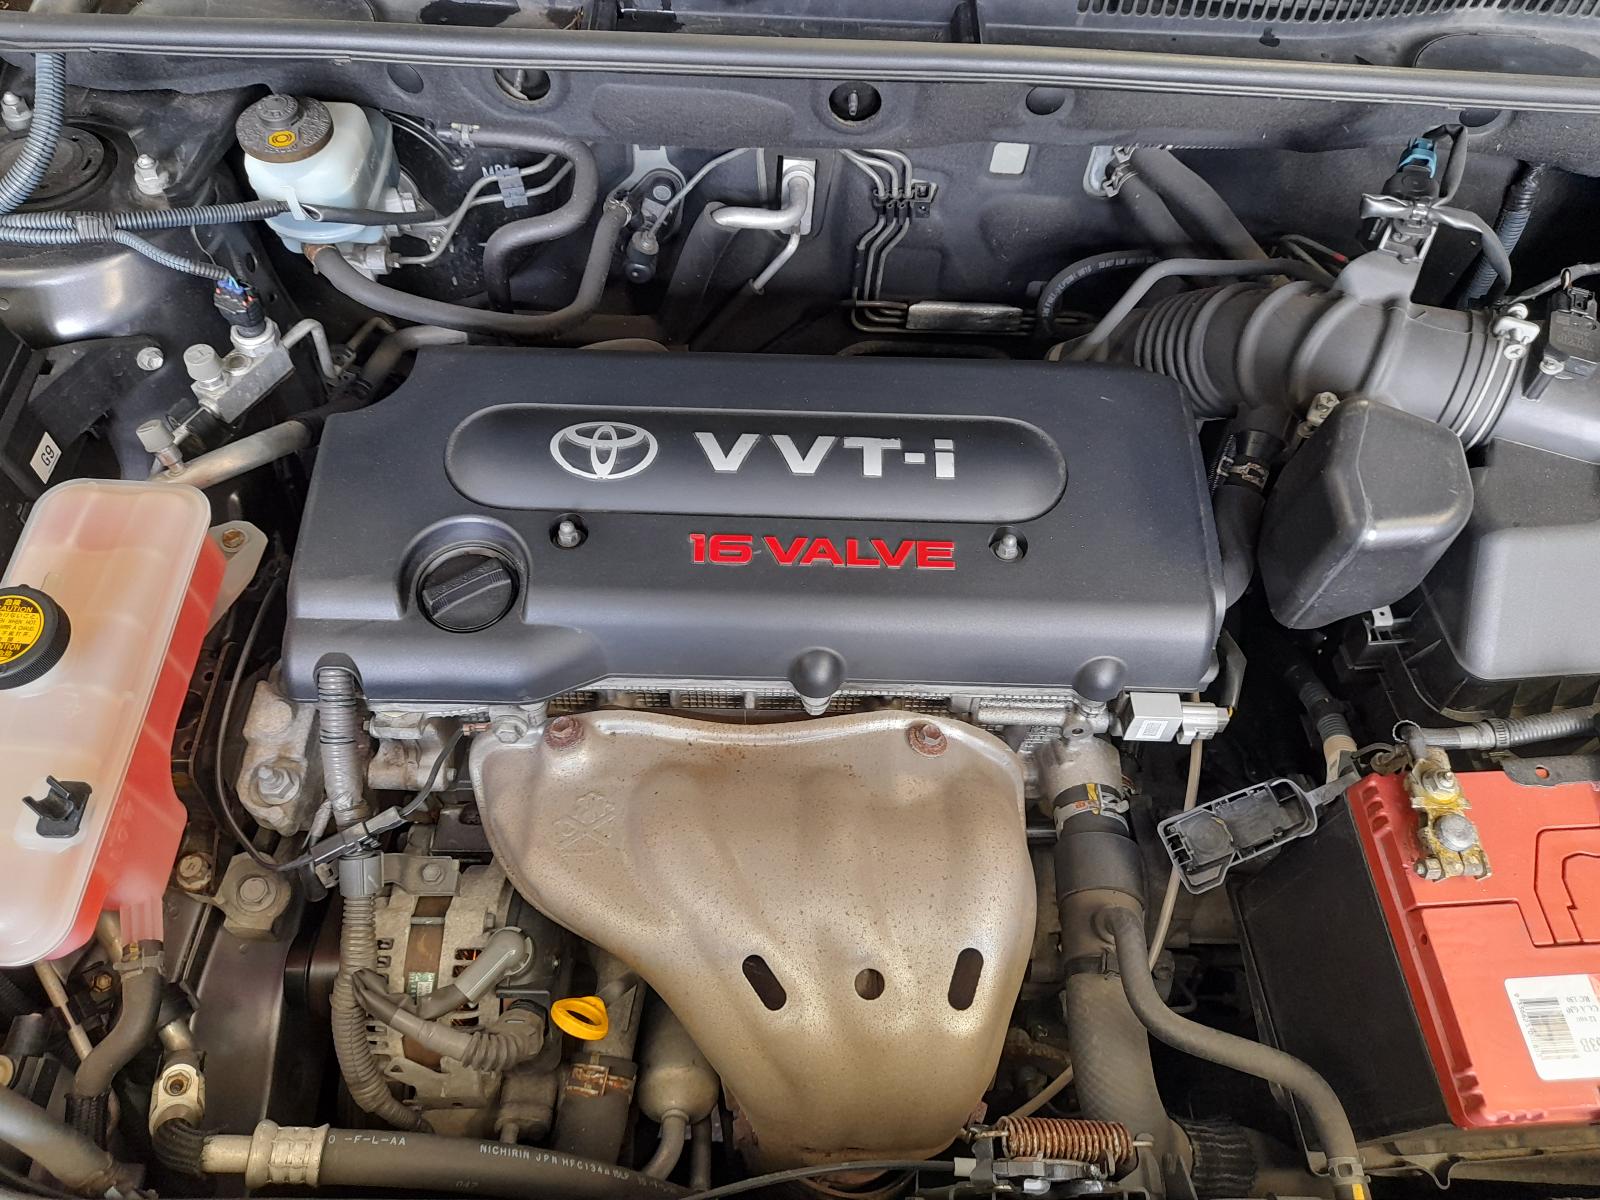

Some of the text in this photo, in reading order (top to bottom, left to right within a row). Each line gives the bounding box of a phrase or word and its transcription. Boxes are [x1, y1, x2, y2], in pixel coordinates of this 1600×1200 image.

[41, 445, 54, 466] G9
[693, 431, 955, 480] VVT-i
[690, 533, 956, 570] 16 VALVE
[480, 1143, 530, 1160] NICHIRIN
